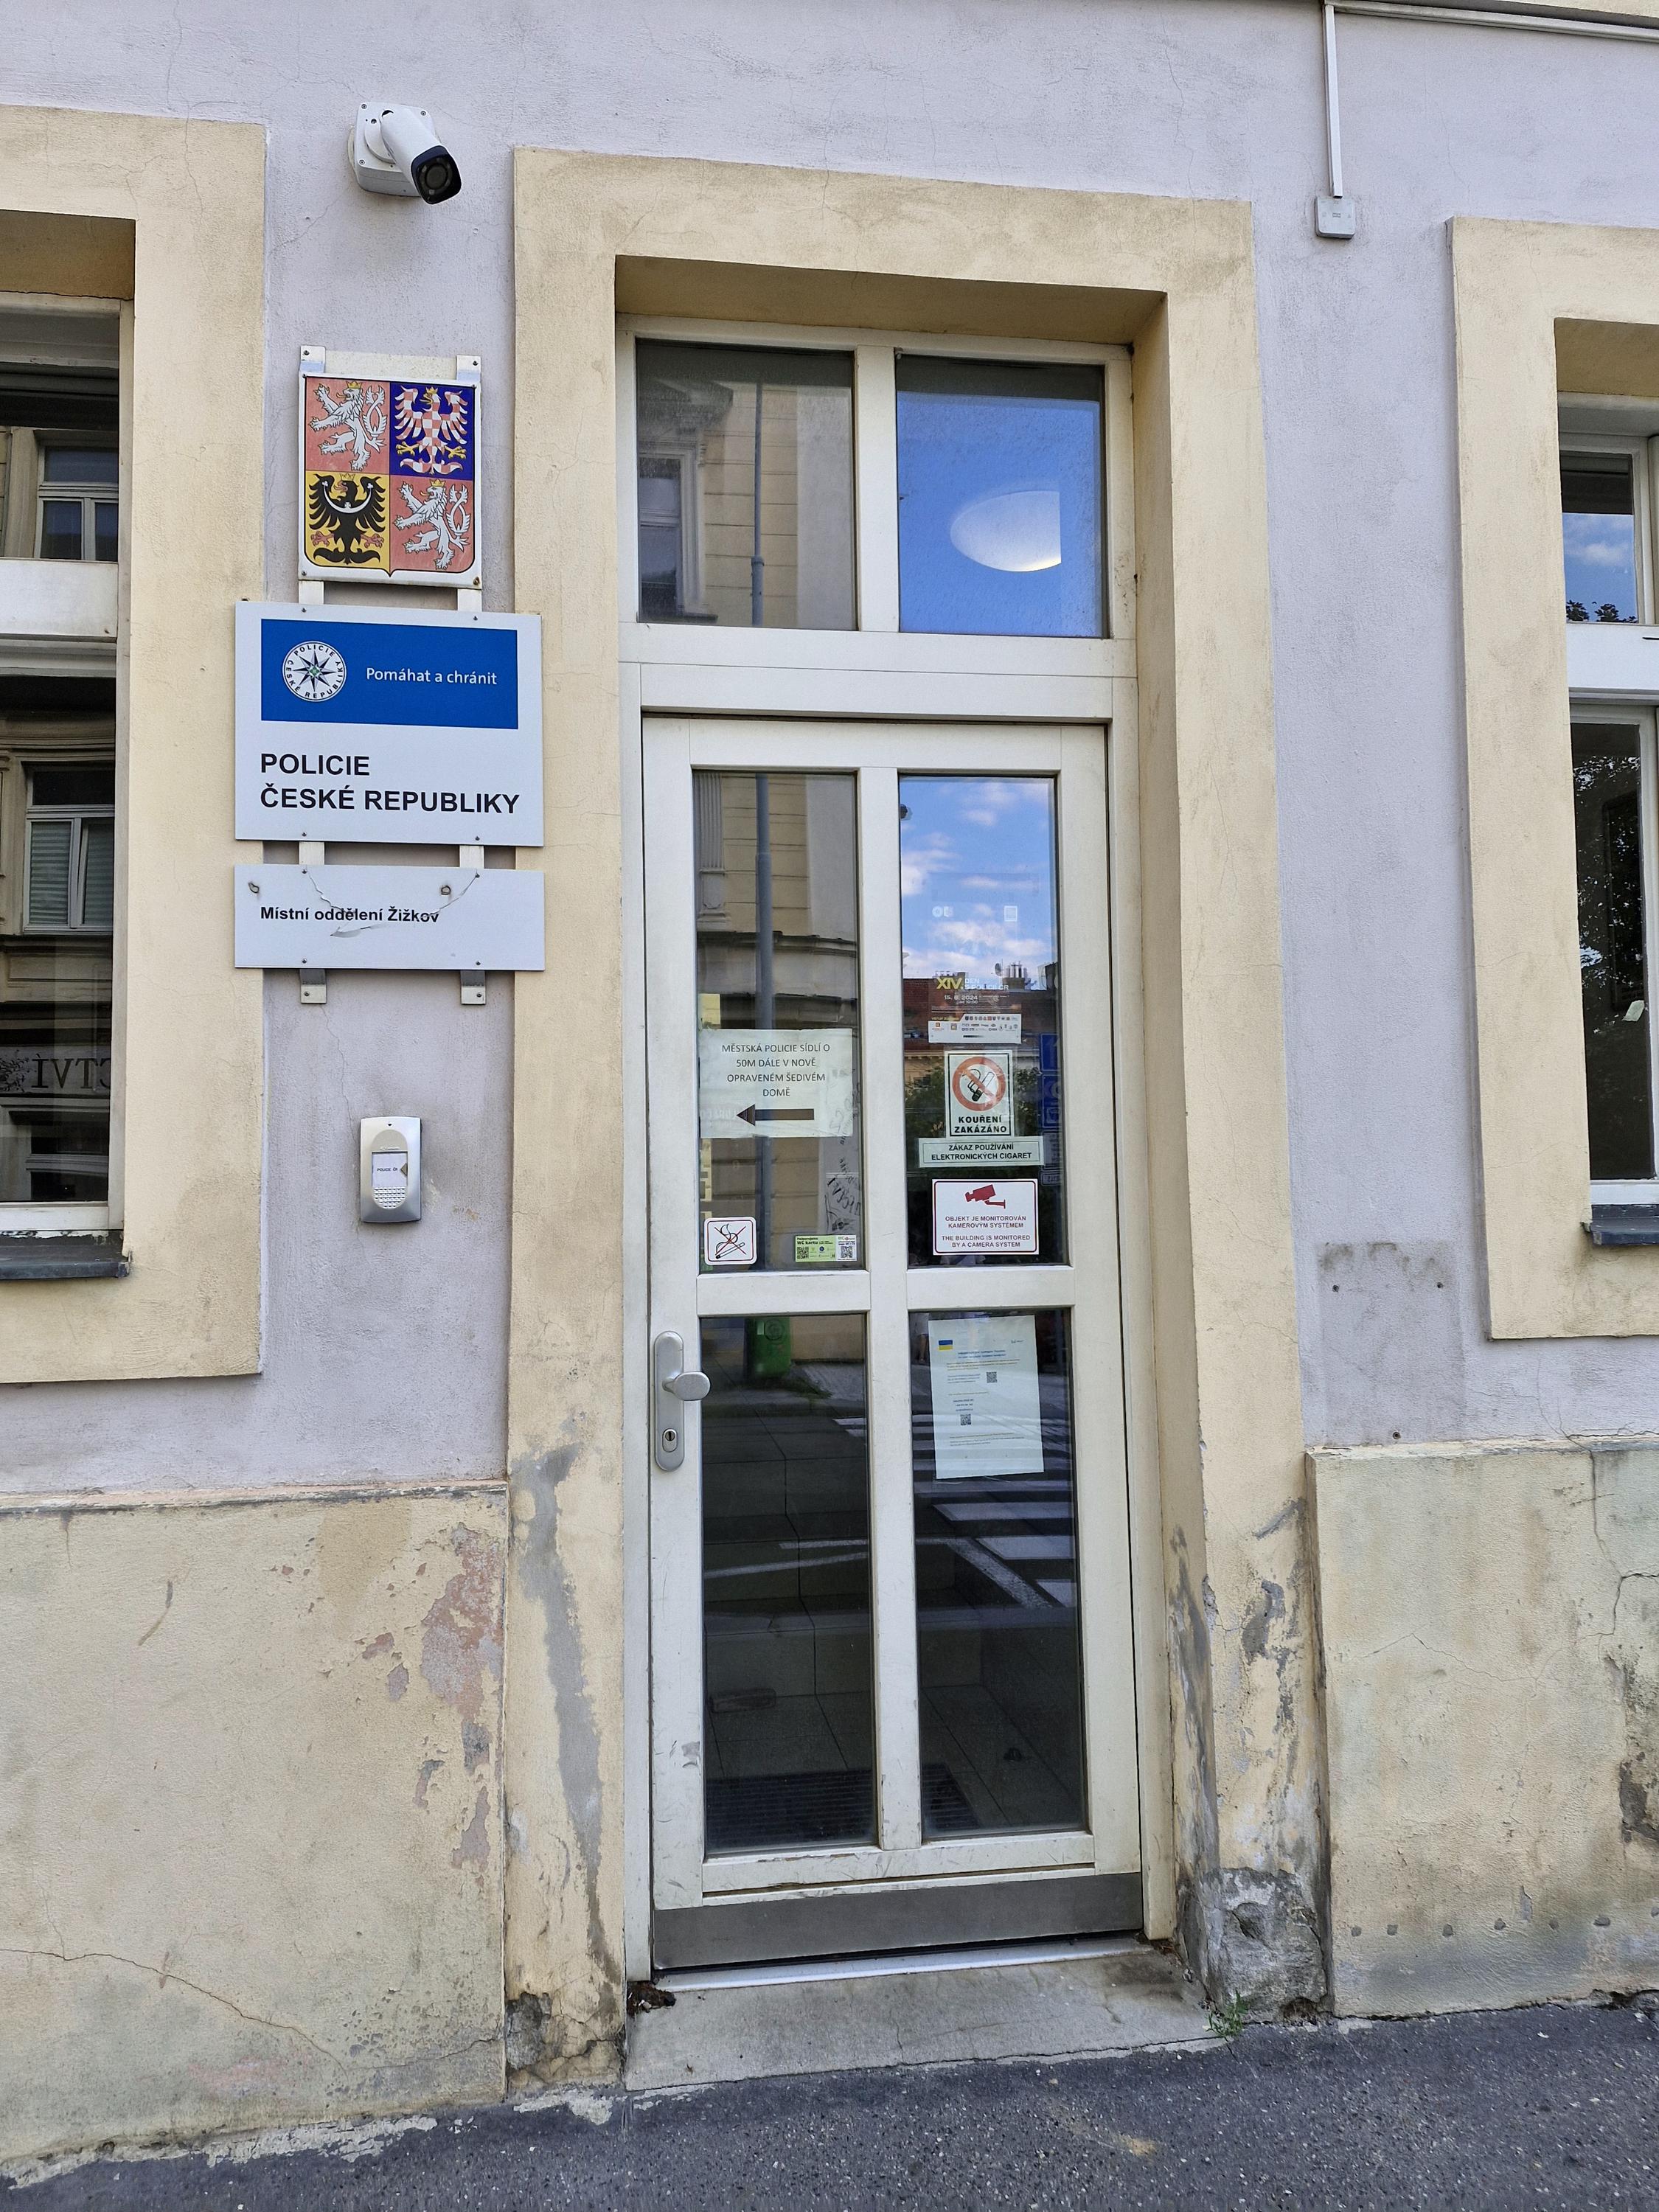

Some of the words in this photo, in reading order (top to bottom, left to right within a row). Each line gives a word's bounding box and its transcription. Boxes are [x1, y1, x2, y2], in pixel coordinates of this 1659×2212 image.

[293, 644, 335, 658] POLICIE
[305, 661, 344, 699] REPUBLIKY
[366, 667, 431, 683] Pomáhat
[434, 672, 442, 683] a
[446, 669, 498, 685] chránit
[260, 753, 370, 776] POLICIE
[260, 782, 355, 810] ČESKÉ
[365, 790, 520, 814] REPUBLIKY
[260, 906, 309, 920] Místní
[314, 907, 383, 921] oddělení
[387, 905, 439, 923] Žižkov
[722, 1043, 762, 1053] MĚSTSKÁ
[765, 1044, 798, 1052] POLICIE
[800, 1042, 821, 1052] SÍDLÍ
[823, 1043, 830, 1052] O
[736, 1059, 756, 1068] 50M
[758, 1057, 781, 1068] DÁLE
[782, 1059, 789, 1067] V
[726, 1072, 784, 1082] OPRAVENÉM
[786, 1071, 826, 1082] ŠEDIVÉM
[762, 1087, 791, 1097] DOMĚ
[958, 1114, 1002, 1124] KOUŘENÍ
[954, 1124, 1007, 1134] ZAKÁZÁNO
[975, 1142, 1014, 1150] POUŽÍVÁNÍ
[931, 1152, 998, 1161] ELEKTRONICKÝCH
[999, 1152, 1032, 1160] CIGARET
